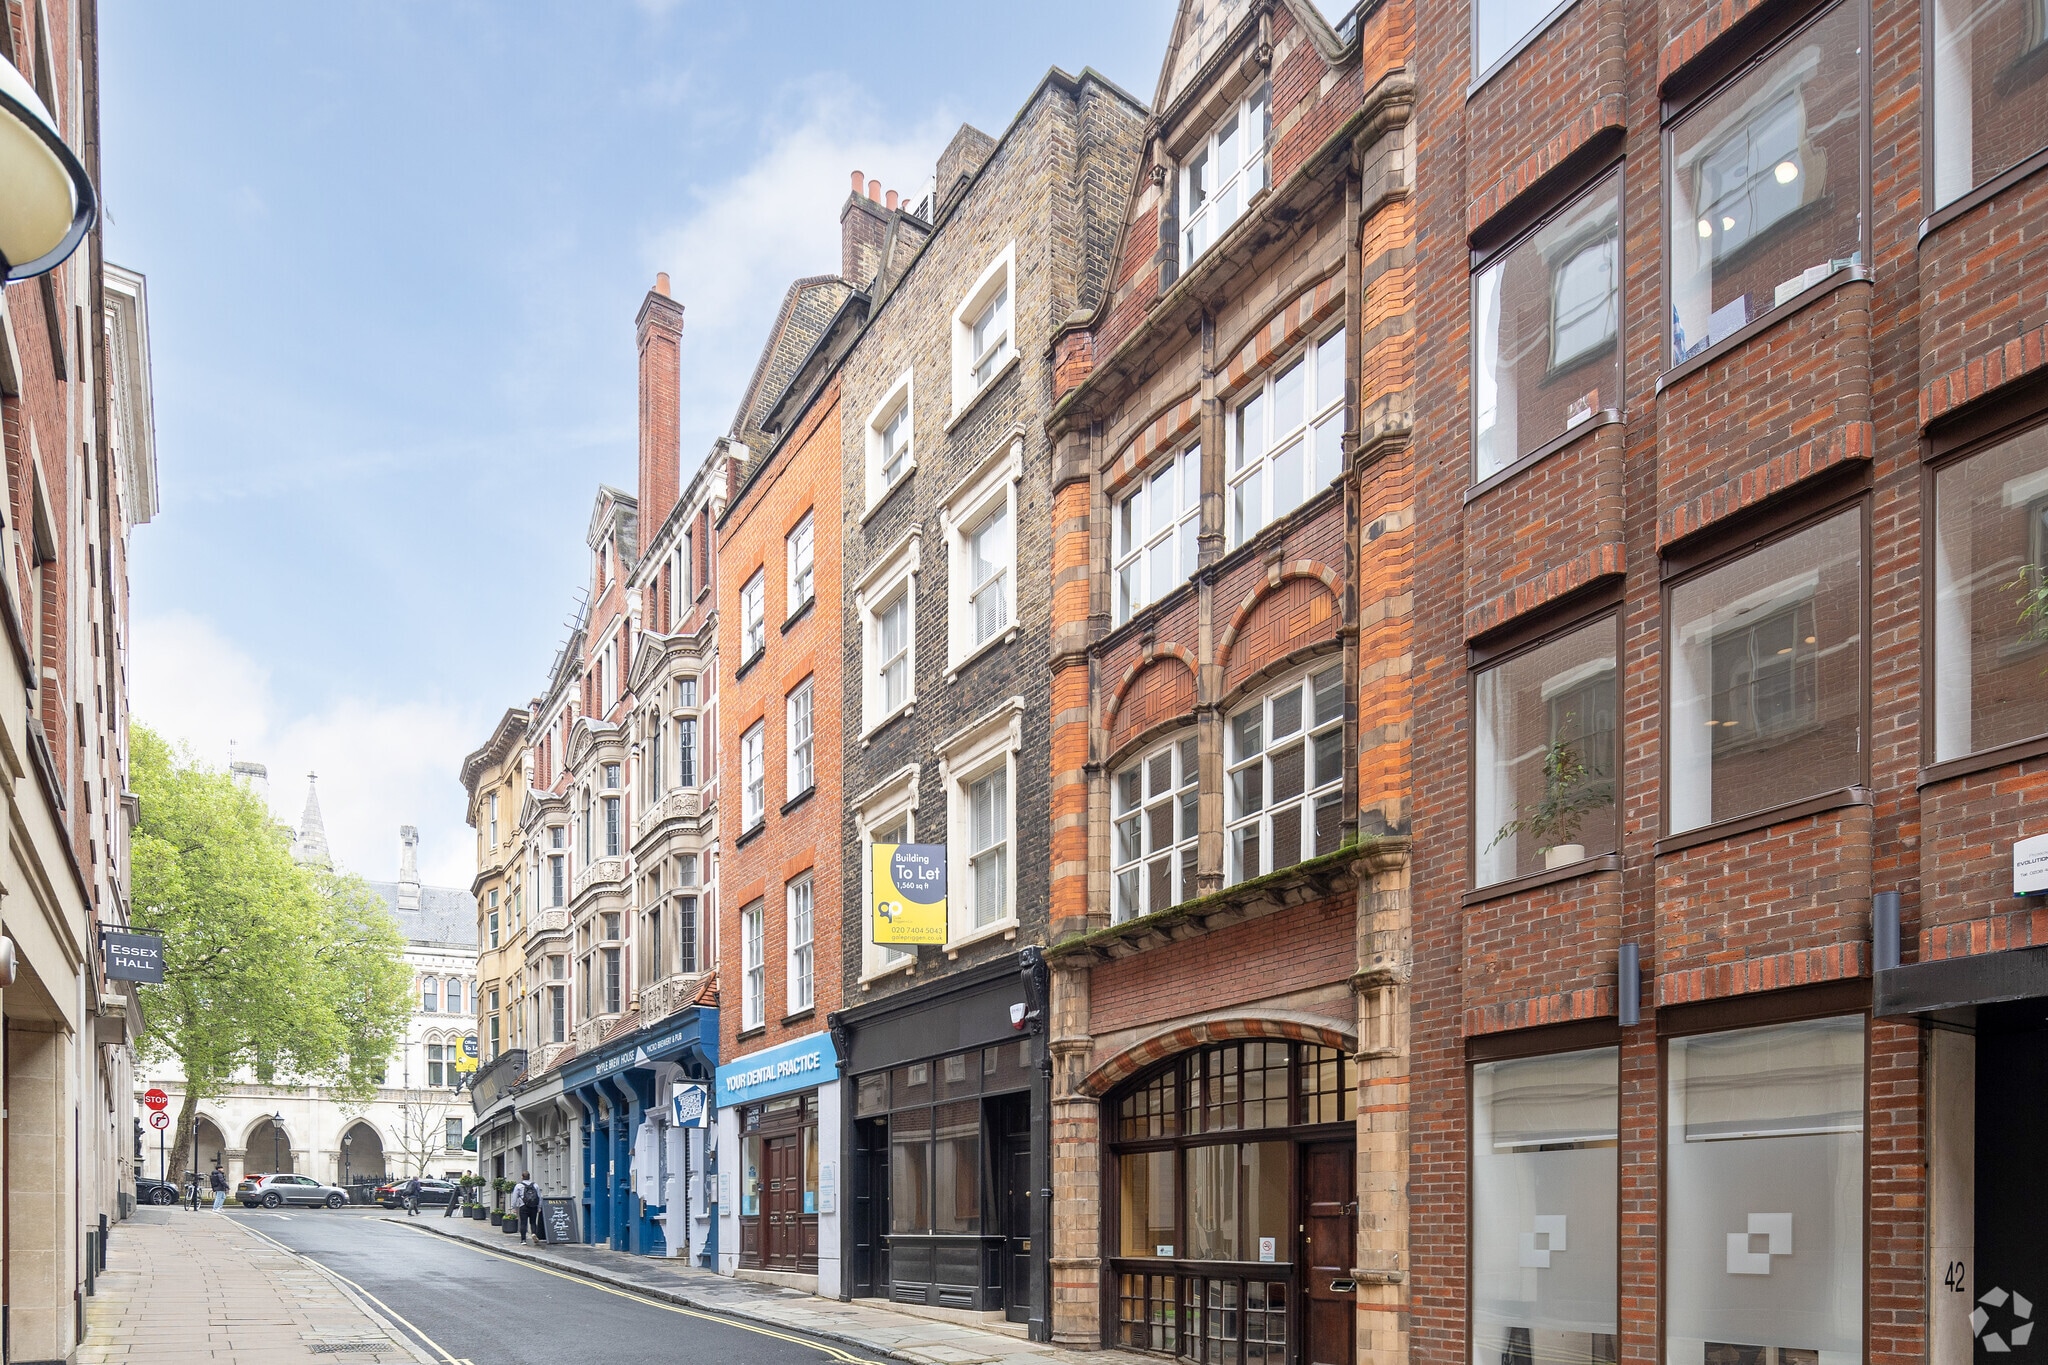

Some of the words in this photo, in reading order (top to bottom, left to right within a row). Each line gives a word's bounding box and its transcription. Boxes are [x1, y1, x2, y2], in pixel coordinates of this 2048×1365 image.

[895, 853, 929, 864] Building
[896, 865, 913, 879] To
[919, 866, 940, 880] Let
[675, 1032, 683, 1042] PUB
[609, 1055, 620, 1069] BREW
[621, 1050, 635, 1064] HOUSE
[726, 1073, 747, 1091] YOUR
[747, 1064, 777, 1086] DENTAL
[777, 1051, 820, 1078] PRACTICE
[1945, 1261, 1965, 1292] 42
